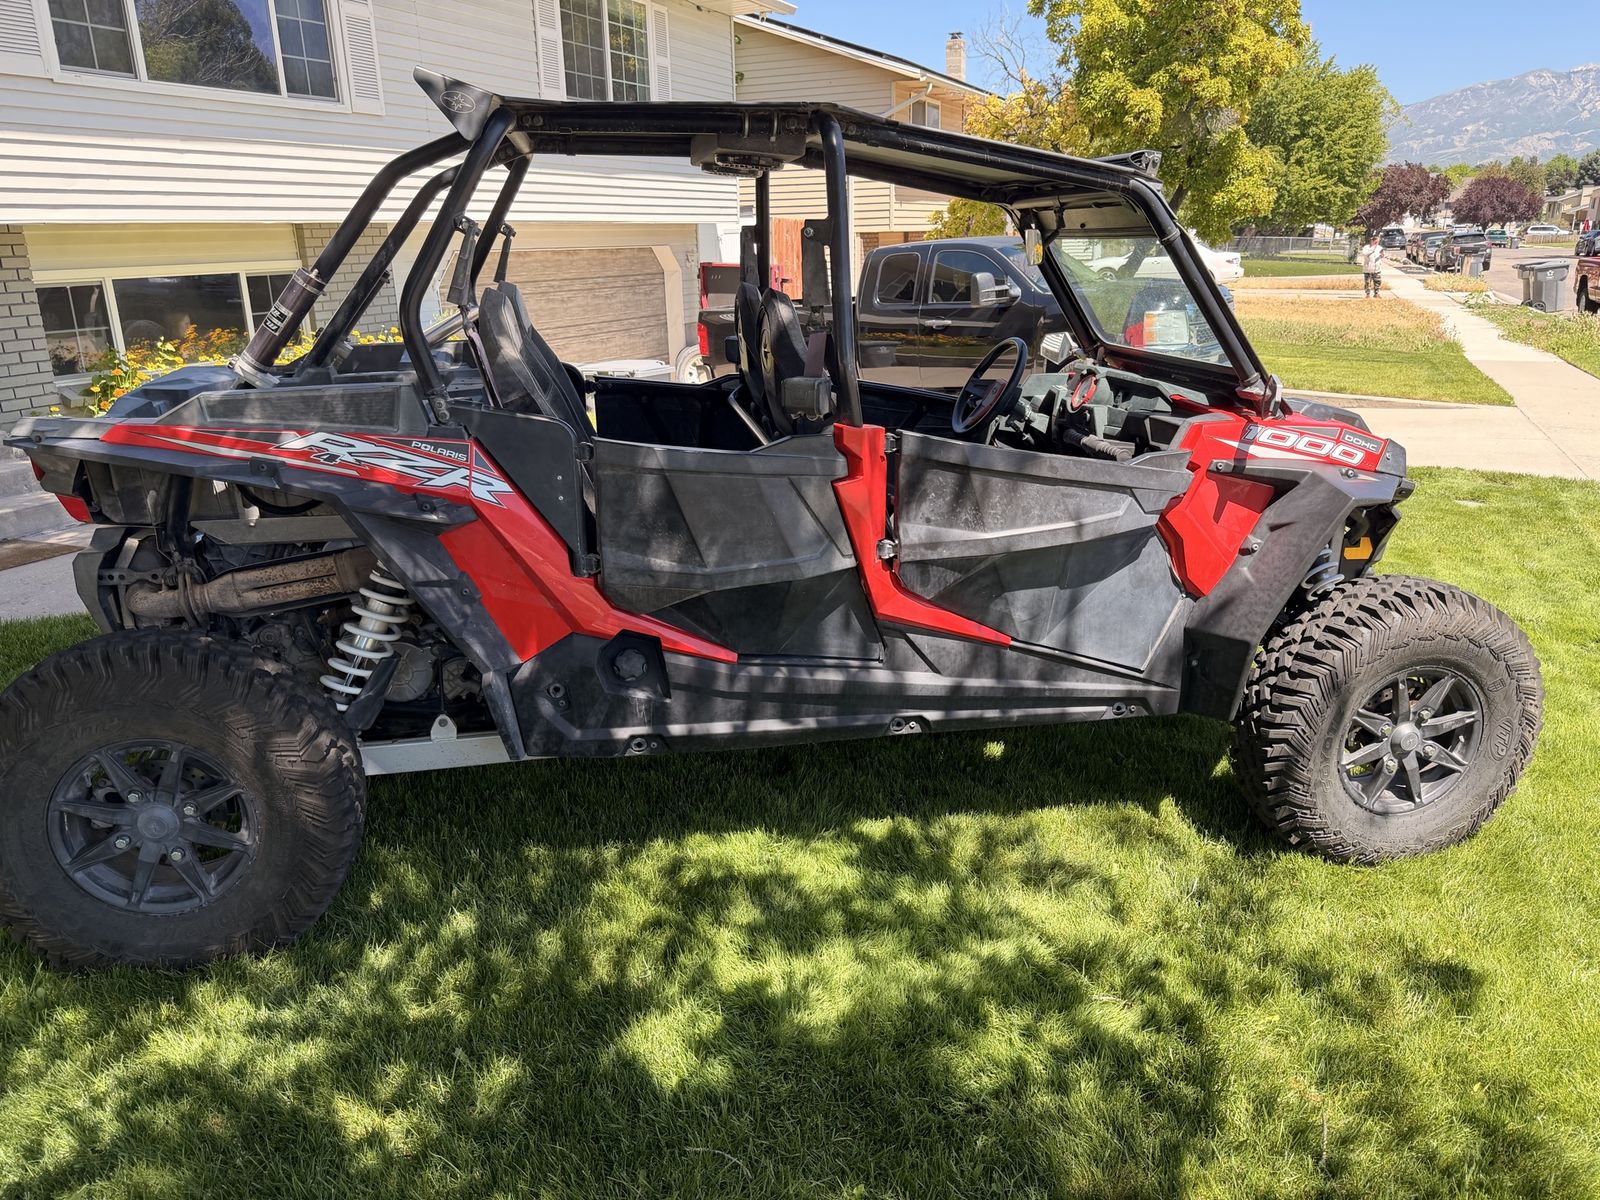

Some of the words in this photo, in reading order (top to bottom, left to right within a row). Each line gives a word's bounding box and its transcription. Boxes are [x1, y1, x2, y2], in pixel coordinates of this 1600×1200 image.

[411, 440, 468, 462] POLARIS
[1243, 424, 1365, 465] 1000
[1344, 434, 1379, 451] DOHC
[270, 432, 513, 509] RZR
[310, 451, 344, 465] 4
[1494, 719, 1513, 758] ITP
